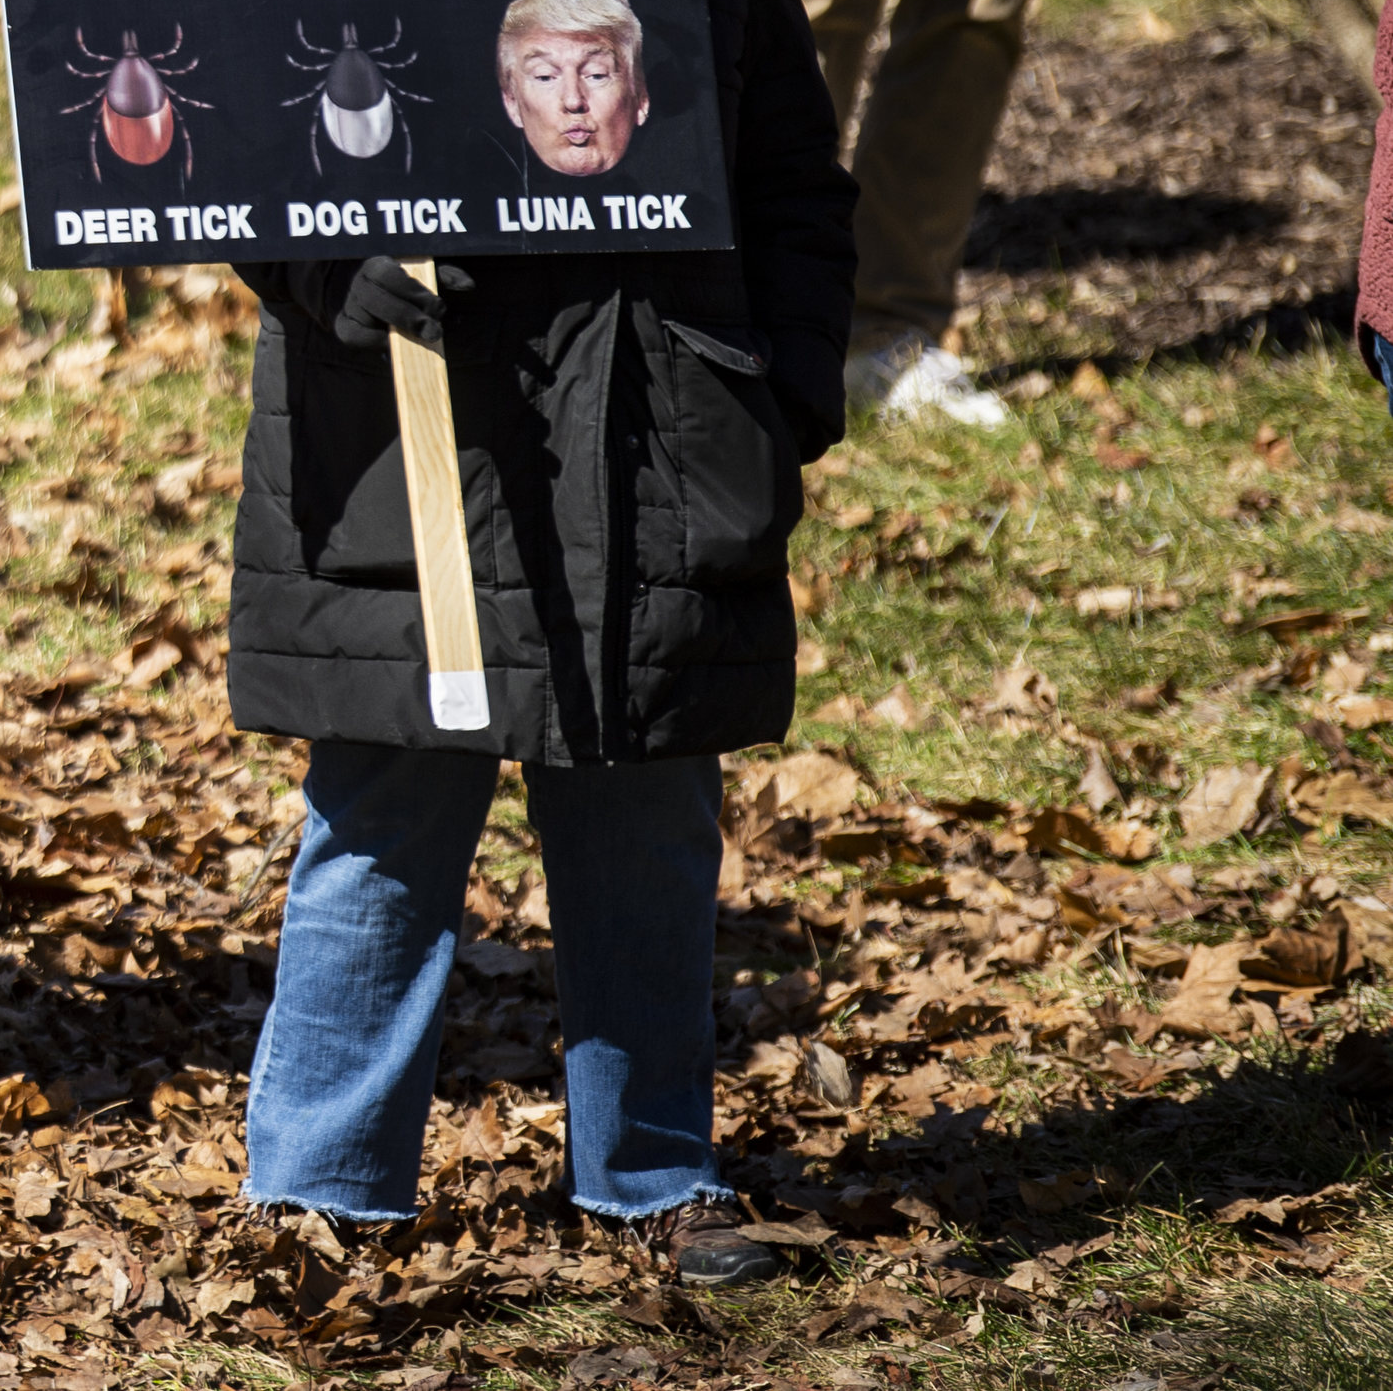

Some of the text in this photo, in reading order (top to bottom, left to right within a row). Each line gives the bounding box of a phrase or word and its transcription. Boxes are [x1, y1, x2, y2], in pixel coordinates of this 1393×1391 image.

[56, 205, 257, 245] DEER TICK
[288, 199, 467, 237] DOG TICK
[498, 194, 692, 233] LUNA TICK
